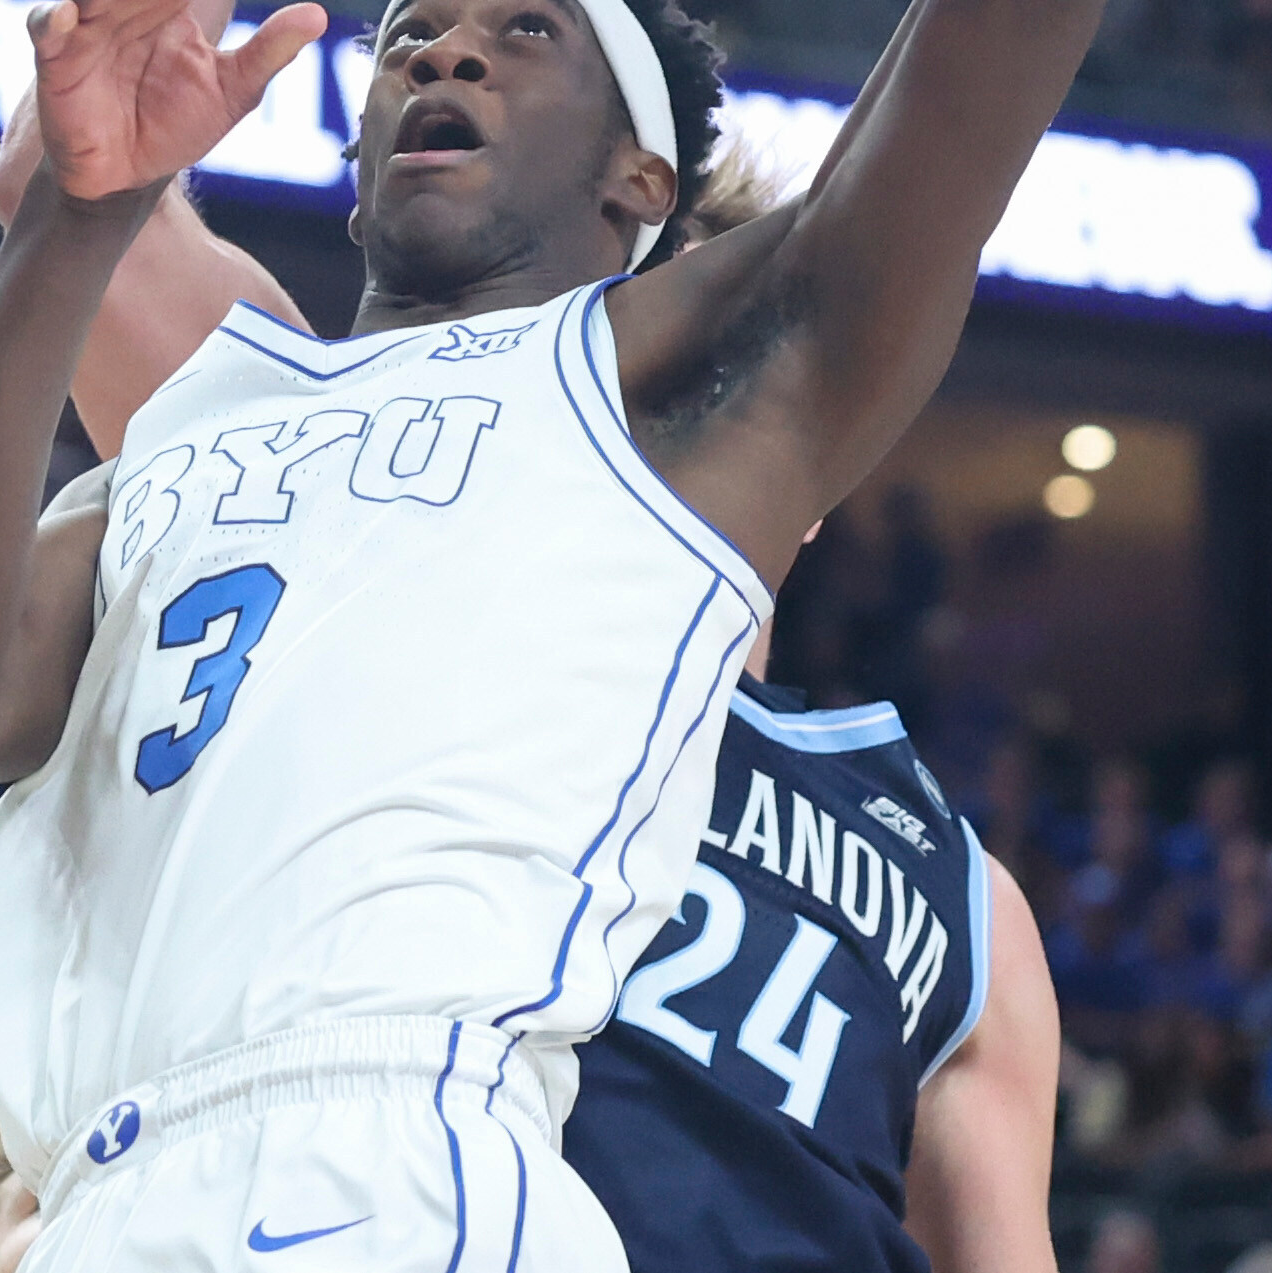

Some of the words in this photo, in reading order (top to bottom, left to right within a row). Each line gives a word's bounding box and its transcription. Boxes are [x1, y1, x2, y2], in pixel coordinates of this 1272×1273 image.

[119, 395, 502, 570] BYU
[134, 562, 287, 796] 3
[616, 861, 852, 1130] 24
